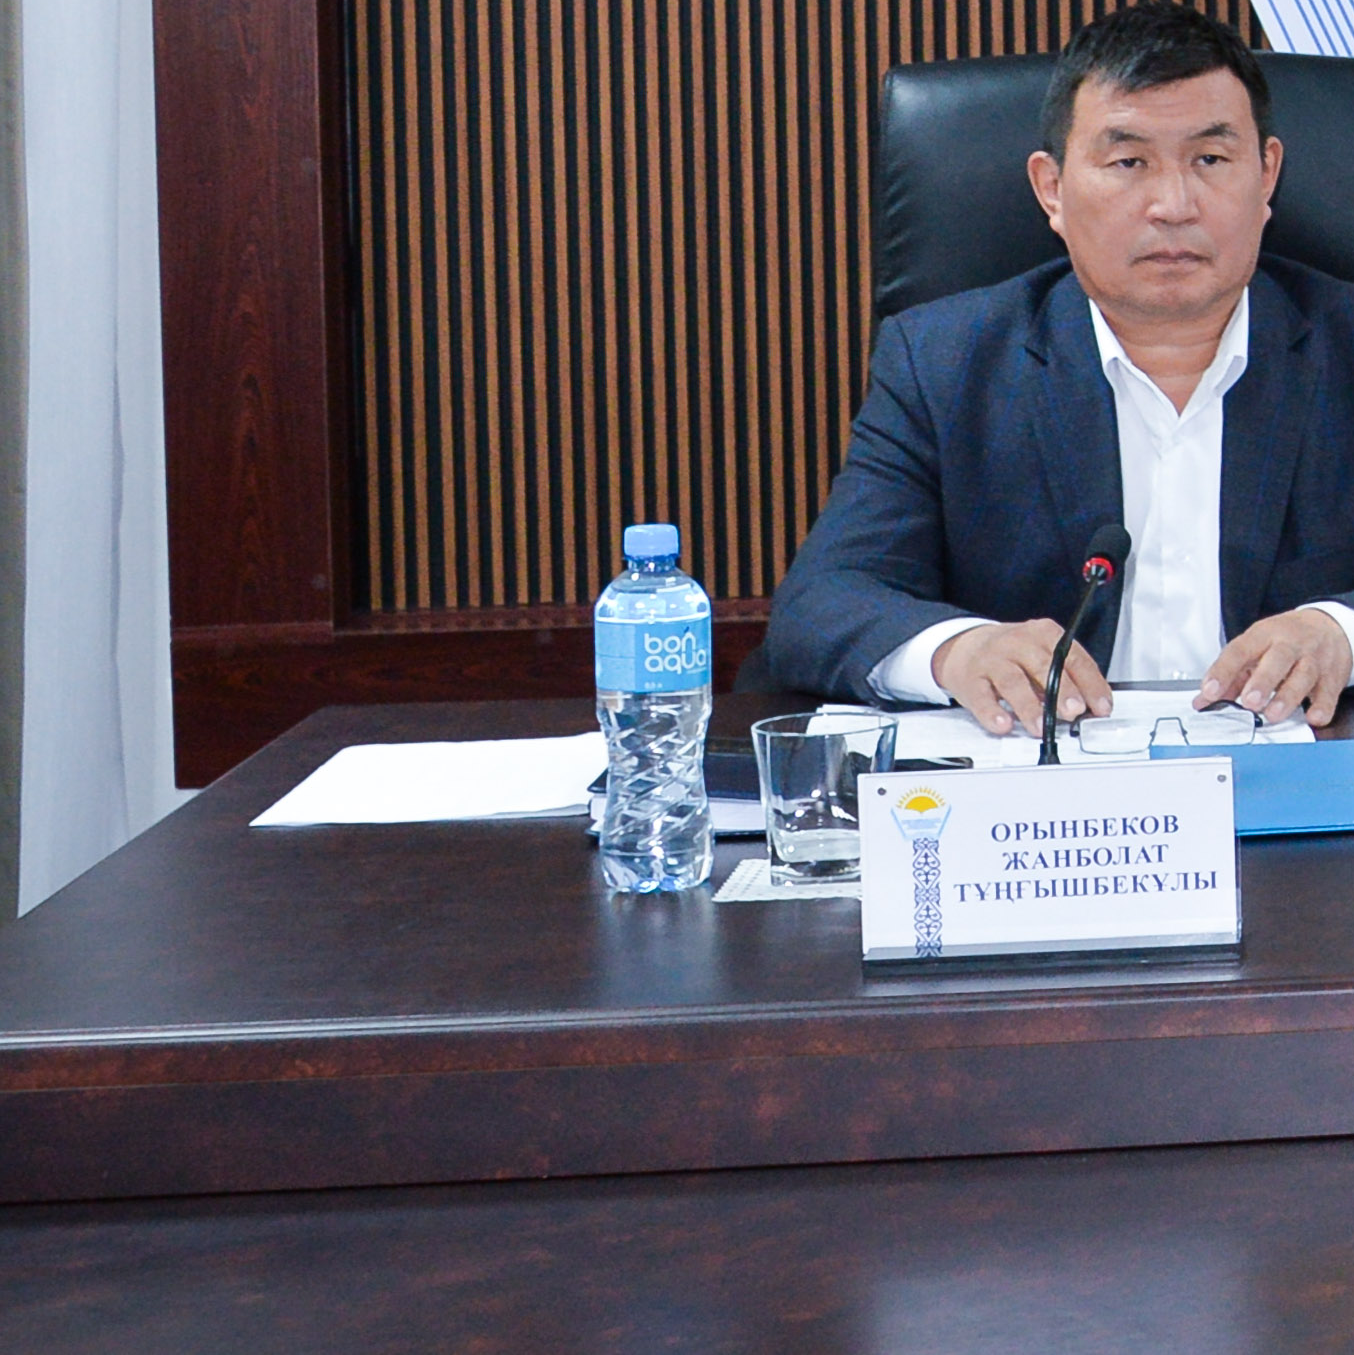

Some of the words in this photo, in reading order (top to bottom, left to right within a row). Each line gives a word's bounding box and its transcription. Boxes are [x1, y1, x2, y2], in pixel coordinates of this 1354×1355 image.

[643, 630, 697, 655] bon
[644, 649, 707, 675] aqua
[990, 814, 1180, 843] ОРЫНБЕКОВ
[1002, 843, 1170, 872] ЖАНБОЛАТ
[953, 870, 1219, 904] ТҰҢҒЫШБЕКҰЛЫ
